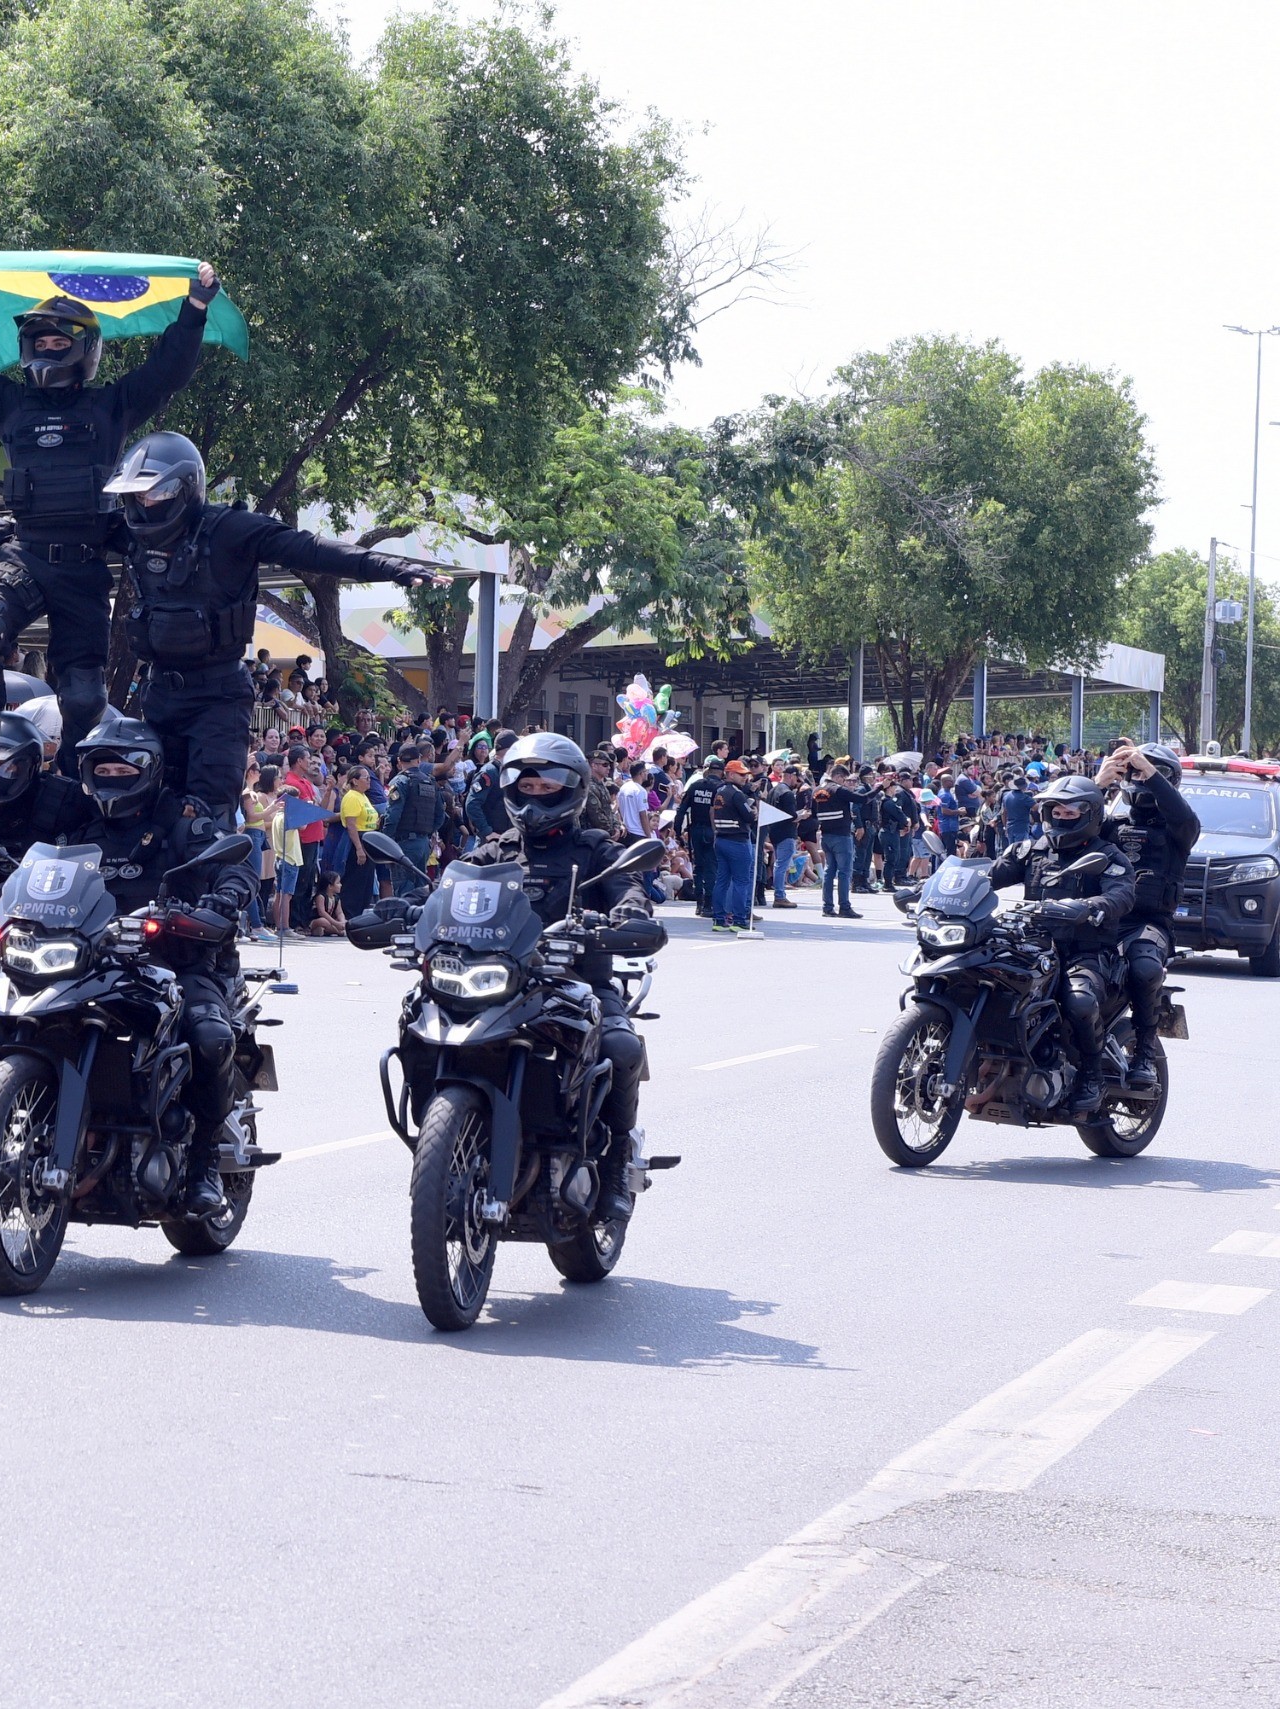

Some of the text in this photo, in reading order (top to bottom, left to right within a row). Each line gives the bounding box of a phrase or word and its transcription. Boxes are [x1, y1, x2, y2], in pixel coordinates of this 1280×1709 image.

[694, 789, 713, 798] POLÍCI
[1178, 786, 1251, 800] VALARIA
[931, 896, 961, 908] PMRR
[22, 902, 67, 917] PMRR
[447, 925, 494, 940] PMRR
